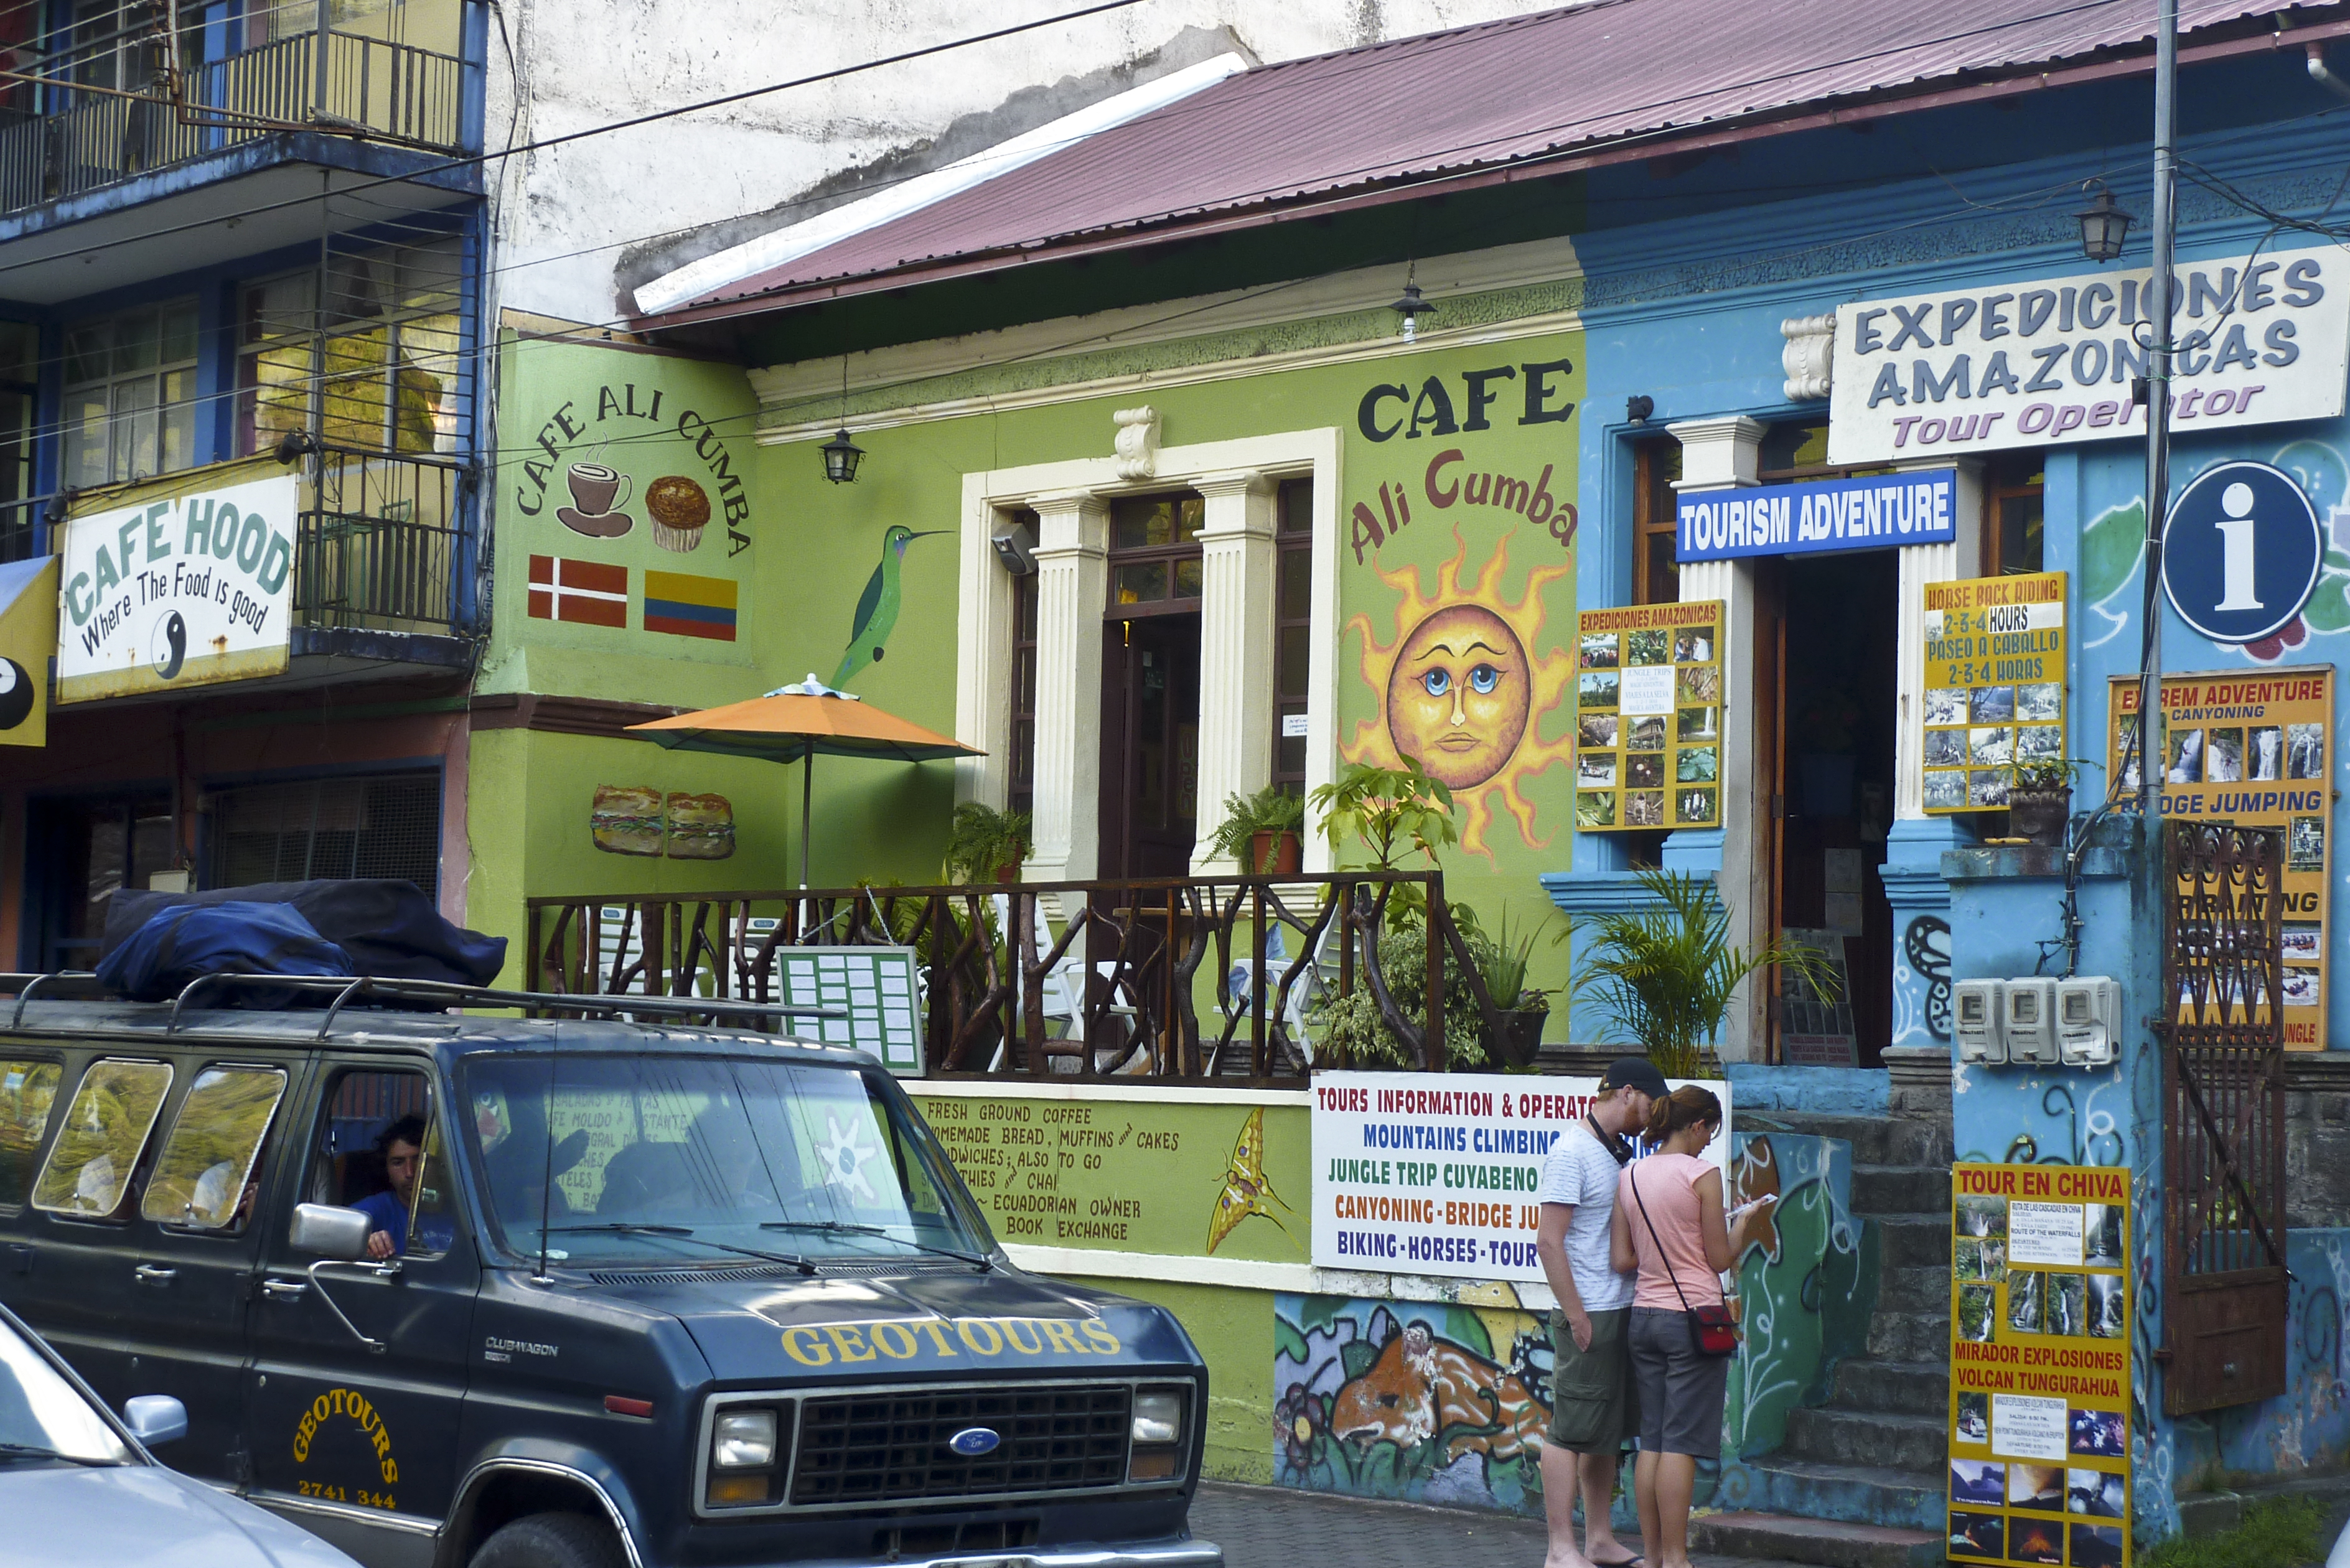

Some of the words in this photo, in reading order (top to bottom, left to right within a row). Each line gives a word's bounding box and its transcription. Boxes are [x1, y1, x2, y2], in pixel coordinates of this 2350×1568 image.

[1854, 259, 2324, 355] EXPEDICIONES
[1866, 319, 2298, 409] AMAZONCAS
[1357, 358, 1575, 442] CAFE
[1893, 411, 2004, 448] Tour
[2016, 385, 2265, 437] Opertor
[518, 402, 586, 515] CAFE
[597, 384, 663, 421] ALI
[678, 410, 751, 558] CUMBA
[1352, 480, 1410, 566] Ali
[1425, 449, 1578, 547] Cumba
[1681, 497, 1790, 551] TOURISM
[1797, 482, 1949, 542] ADVENTURE
[185, 499, 290, 595] HOOD
[82, 591, 131, 657] Where
[138, 571, 167, 608] The
[174, 562, 211, 599] Food
[228, 590, 268, 634] good
[1929, 586, 1970, 610] HORSE
[1977, 583, 2009, 605] BACK
[2015, 580, 2057, 602] RIDING
[1581, 610, 1649, 631] EXPEDICIONES
[1651, 604, 1716, 626] AMAZONICAS
[1944, 612, 1986, 634] 2-3-4
[1989, 605, 2028, 633] HOURS
[1929, 637, 1973, 661] PASEO
[1979, 637, 1987, 656] A
[1993, 631, 2059, 655] CABALLO
[1949, 662, 1991, 684] 2-3-4
[1997, 658, 2043, 681] HORAS
[2122, 687, 2198, 709] EXREM
[2204, 680, 2323, 705] ADVENTURE
[2171, 706, 2264, 721] CANYONING
[2120, 795, 2203, 815] BDGE
[2210, 791, 2321, 813] JUMPING
[927, 1102, 968, 1119] FRESH
[980, 1104, 1031, 1122] GROUND
[1043, 1108, 1092, 1124] COFFEE
[1318, 1088, 1368, 1113] TOURS
[1378, 1090, 1493, 1116] INFORMATION
[1502, 1093, 1513, 1117] &
[1520, 1094, 1597, 1120] OPERATO
[1059, 1130, 1113, 1148] MUFFINS
[1118, 1122, 1133, 1146] and
[1136, 1132, 1179, 1152] CAKES
[1364, 1124, 1466, 1152] MOUNTAINS
[1018, 1151, 1049, 1168] ALSO
[1059, 1152, 1074, 1168] TO
[1084, 1154, 1101, 1169] GO
[1004, 1166, 1018, 1189] and
[1027, 1172, 1057, 1190] CHAI
[1329, 1159, 1390, 1184] JUNGLE
[1397, 1162, 1437, 1187] TRIP
[1443, 1164, 1537, 1192] CUYABENO
[1959, 1170, 2016, 1193] TOUR
[2023, 1172, 2049, 1195] EN
[2058, 1174, 2123, 1197] CHIVA
[993, 1194, 1077, 1215] ECUADORIAN
[1090, 1197, 1141, 1218] OWNER
[1007, 1216, 1043, 1235] BOOK
[1058, 1221, 1128, 1241] EXCHANGE
[781, 1319, 1121, 1366] GEOTOURS
[1955, 1342, 2019, 1364] MIRADOR
[2024, 1347, 2123, 1370] EXPLOSIONES
[1957, 1368, 2013, 1388] VOLCAN
[2018, 1372, 2120, 1397] TUNGURAHUA
[294, 1389, 398, 1484] GEOTOURS
[299, 1480, 346, 1501] 2741
[358, 1490, 396, 1509] 344
